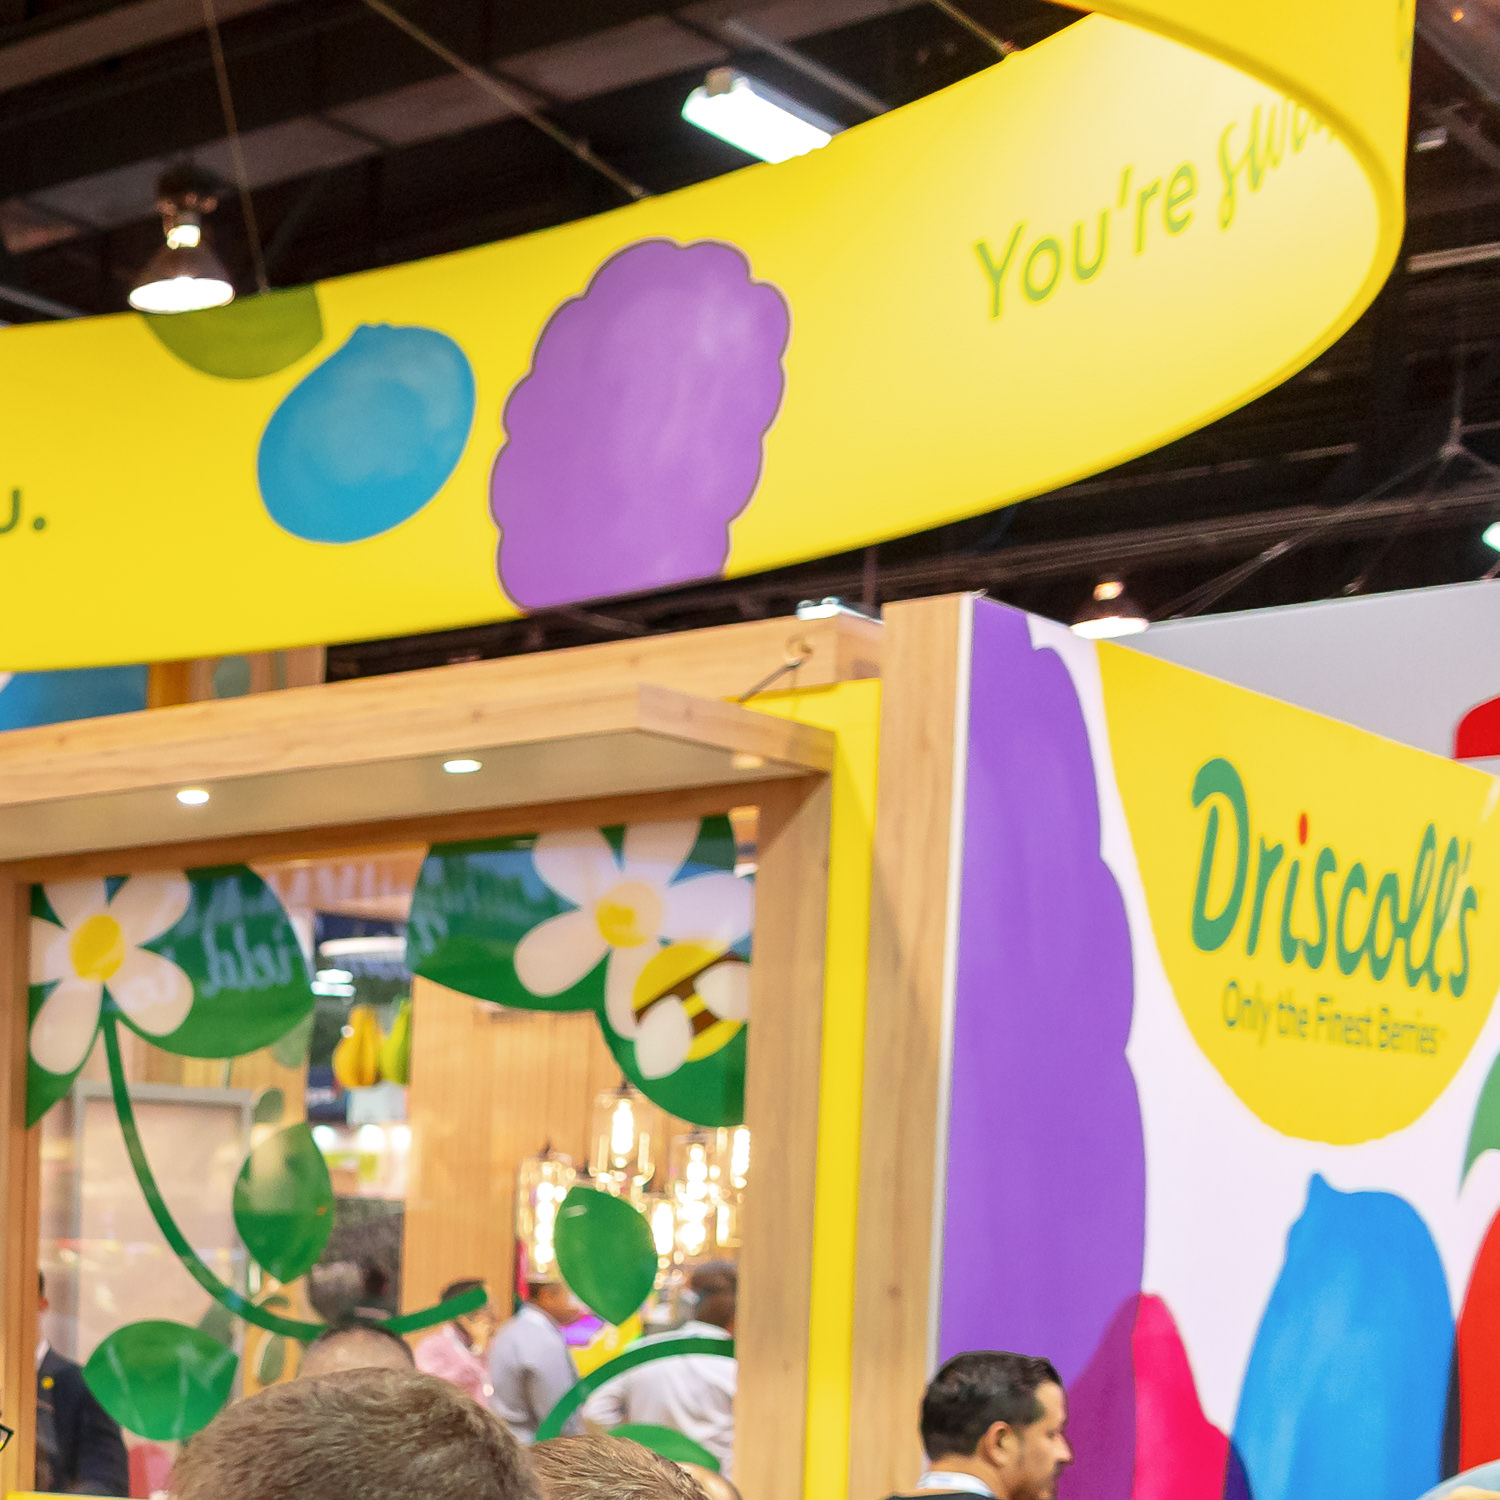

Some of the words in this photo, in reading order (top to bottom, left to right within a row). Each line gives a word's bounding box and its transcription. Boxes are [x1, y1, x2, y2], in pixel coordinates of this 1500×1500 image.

[975, 165, 1197, 320] You're
[1191, 757, 1478, 998] Driscoll's
[1224, 979, 1272, 1048] Only
[1278, 990, 1309, 1040] the
[1316, 994, 1373, 1047] Finest
[1379, 1003, 1440, 1056] Berries
